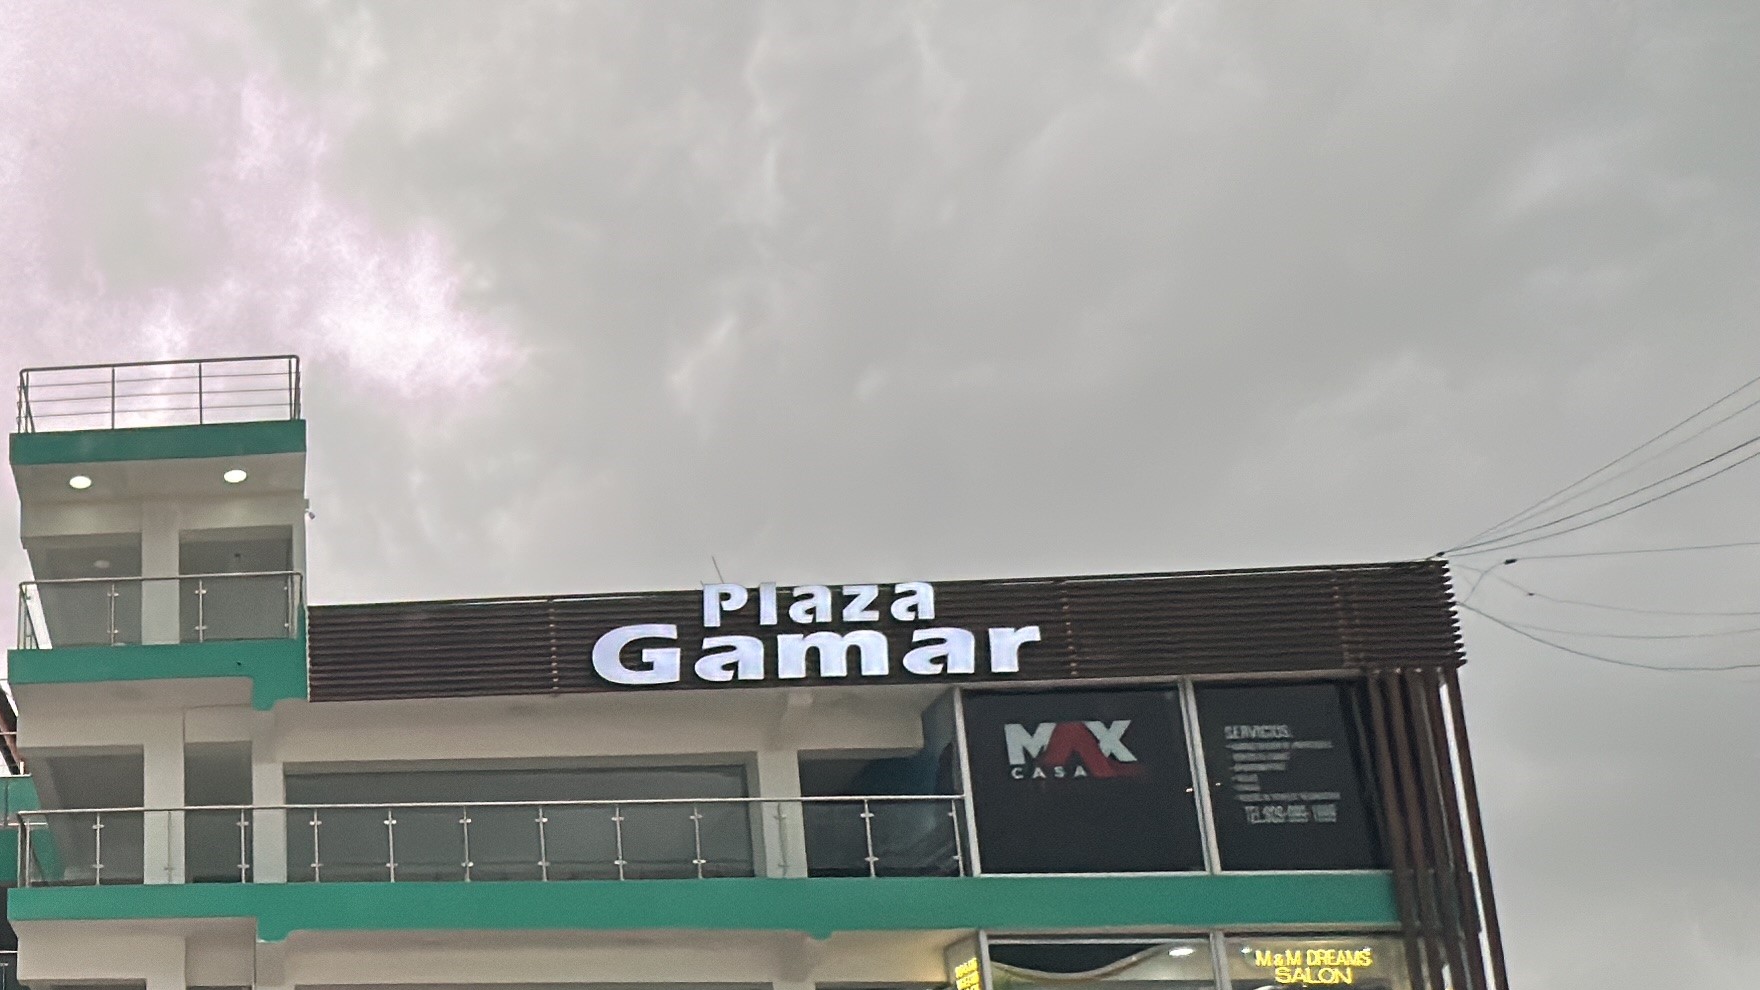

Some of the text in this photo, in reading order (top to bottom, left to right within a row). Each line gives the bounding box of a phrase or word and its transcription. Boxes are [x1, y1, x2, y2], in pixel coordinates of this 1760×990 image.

[702, 581, 935, 627] Plaza
[591, 624, 1042, 685] Gamar
[1004, 720, 1147, 780] MAX
[1010, 765, 1088, 779] CASA
[1255, 950, 1272, 966] M
[1285, 950, 1302, 966] M
[1306, 949, 1373, 967] DREAMS
[1274, 967, 1354, 984] SALON
